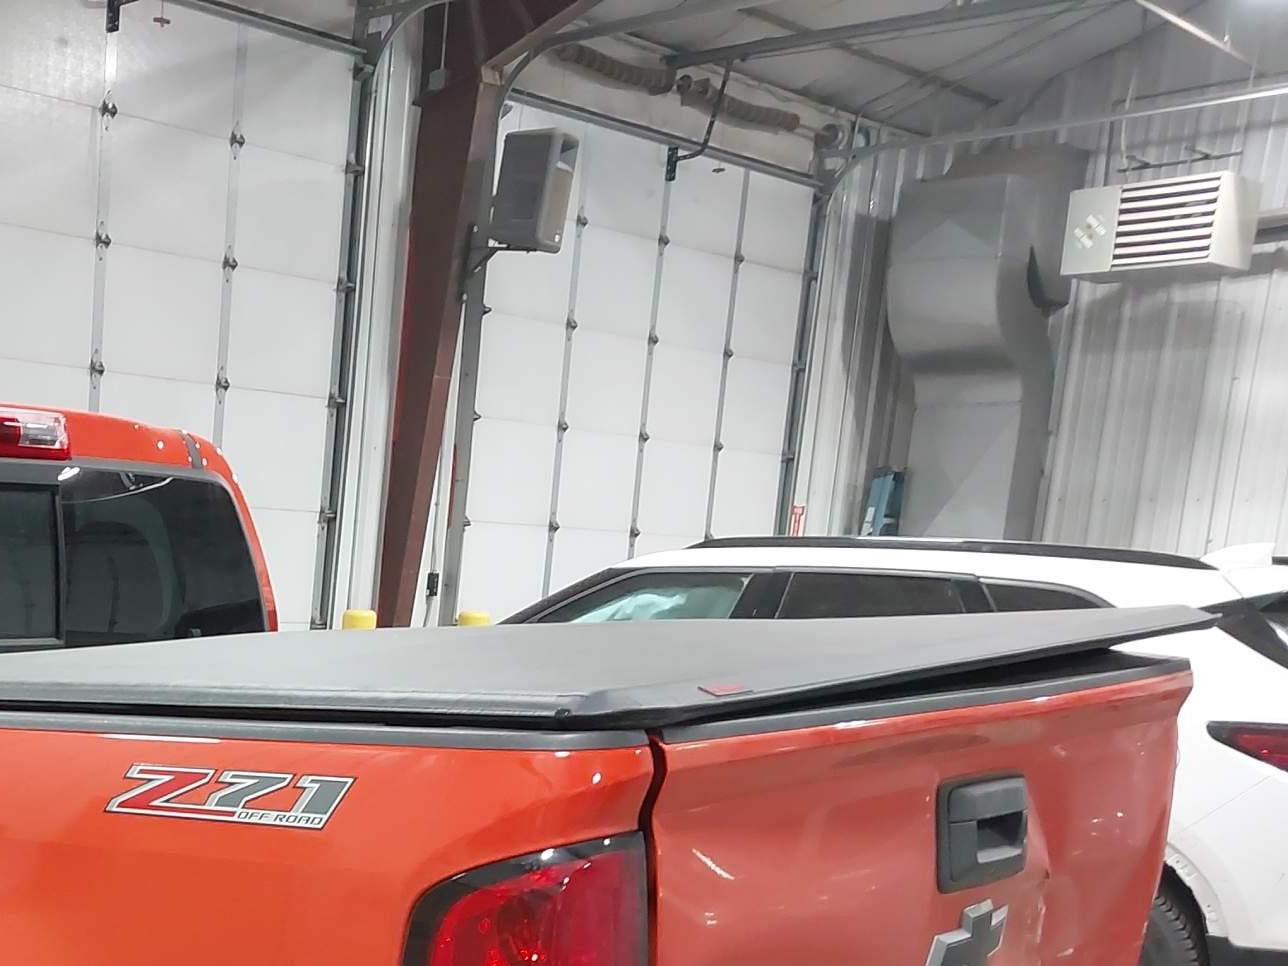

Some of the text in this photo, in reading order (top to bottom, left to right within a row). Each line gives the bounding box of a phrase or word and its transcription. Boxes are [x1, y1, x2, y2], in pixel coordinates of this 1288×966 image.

[104, 763, 357, 826] Z71
[237, 811, 323, 826] OFF ROAD
